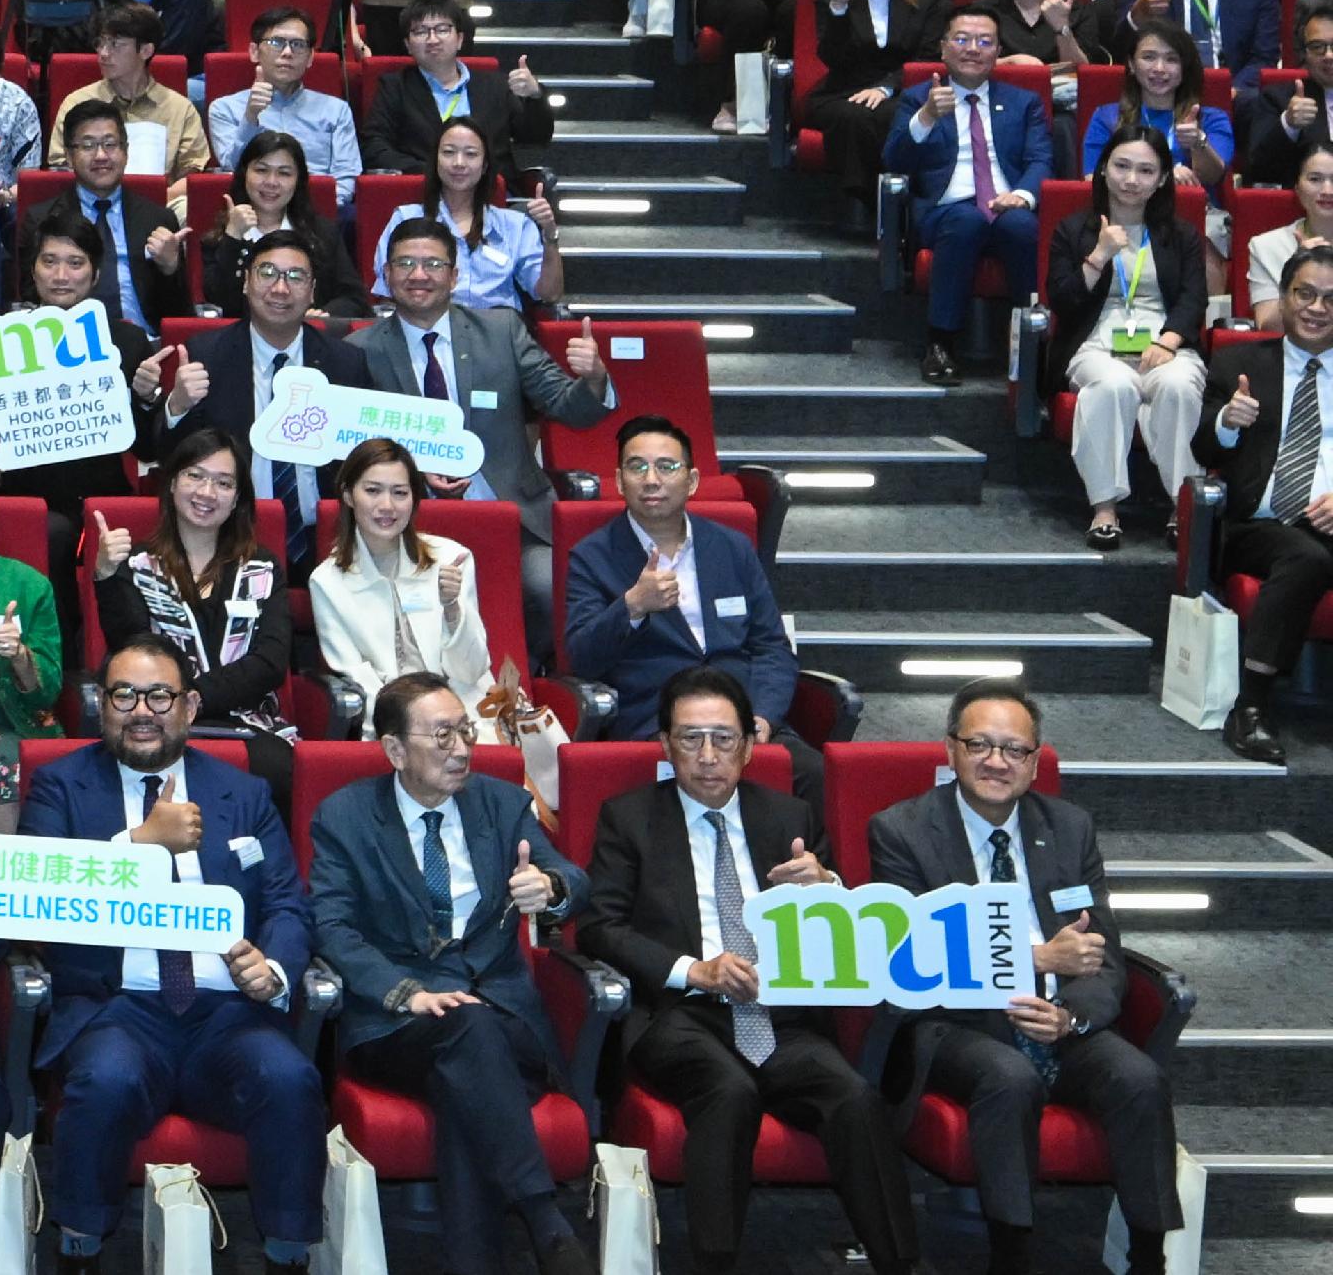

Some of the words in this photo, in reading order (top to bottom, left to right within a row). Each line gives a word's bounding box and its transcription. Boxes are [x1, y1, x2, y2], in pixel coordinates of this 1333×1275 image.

[9, 407, 55, 425] HONG
[60, 400, 105, 416] KONG
[358, 406, 446, 436] 應用科學
[15, 431, 109, 457] UNIVERSITY
[107, 900, 232, 932] TOGETHER
[761, 901, 983, 992] mu
[987, 901, 1015, 990] HKMU
